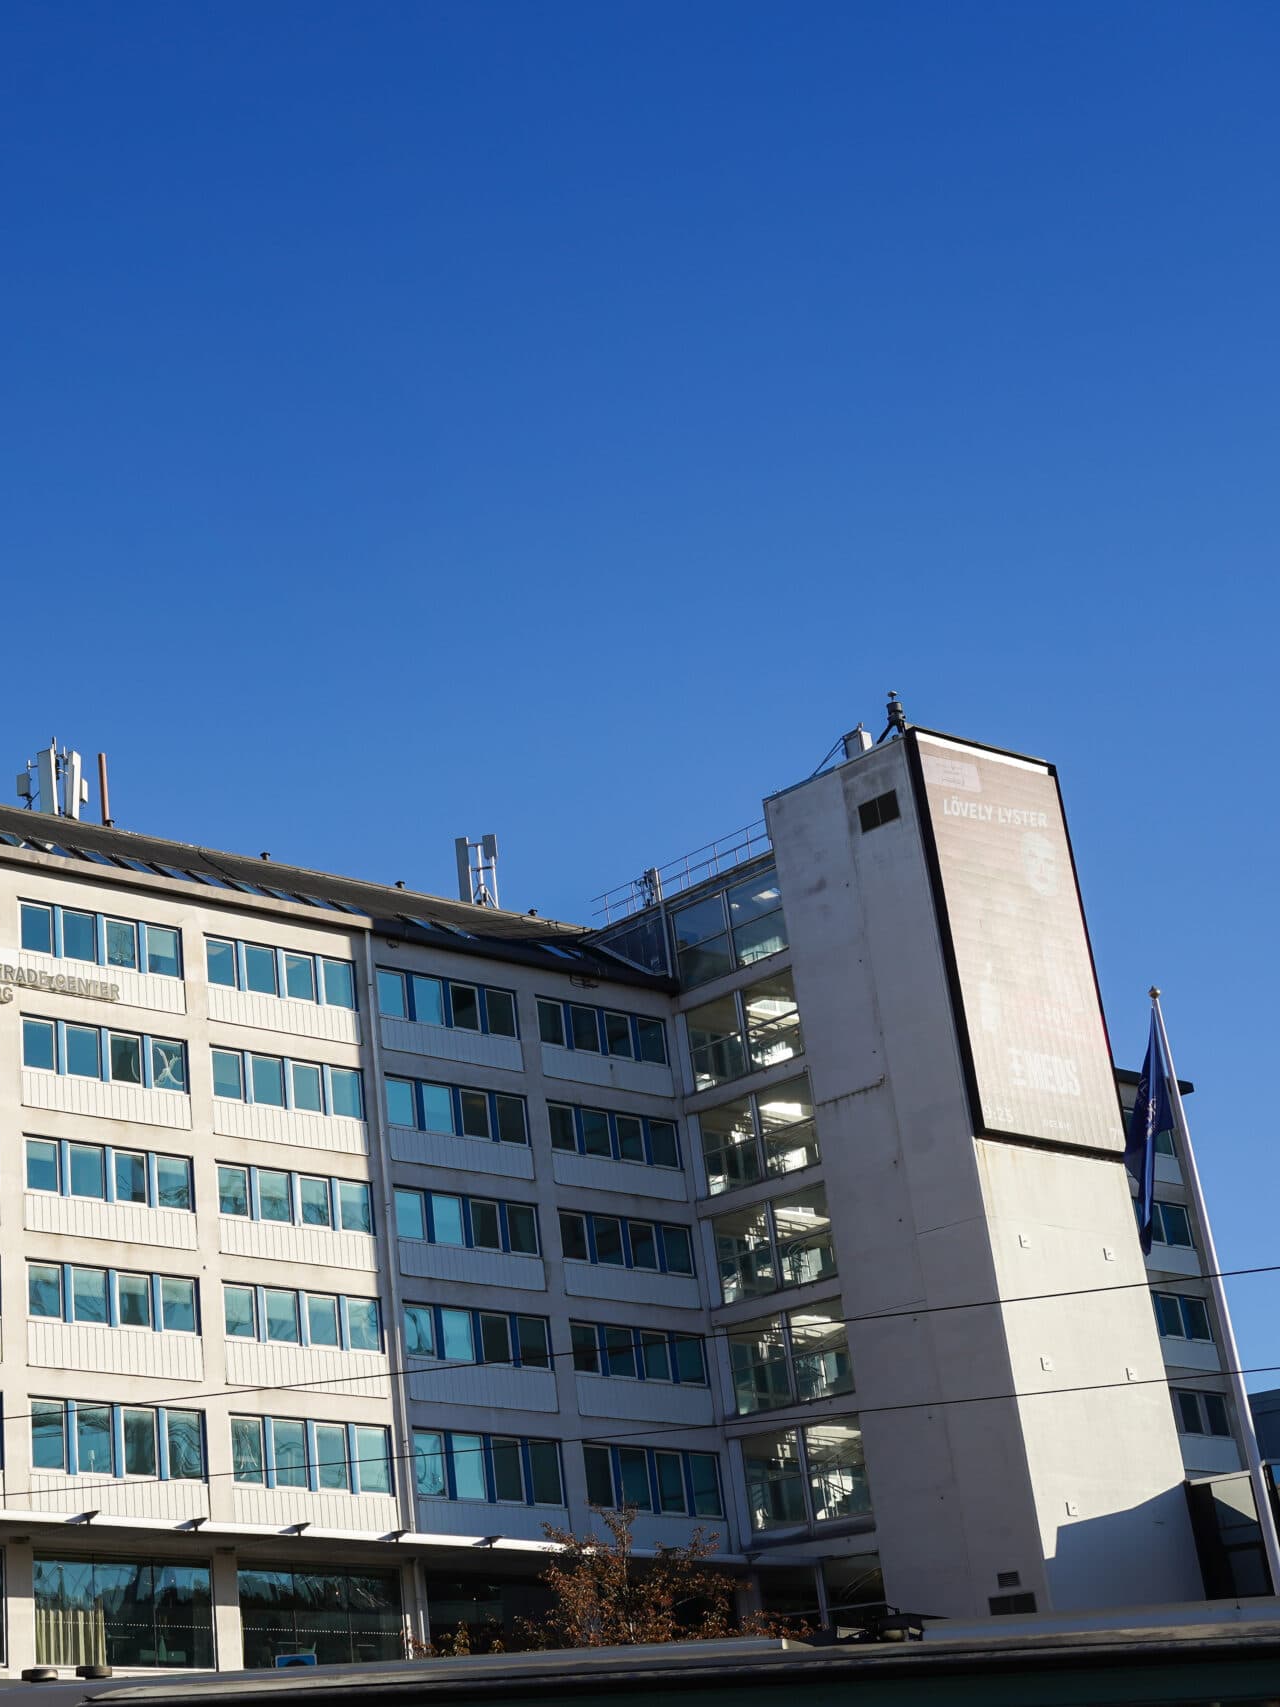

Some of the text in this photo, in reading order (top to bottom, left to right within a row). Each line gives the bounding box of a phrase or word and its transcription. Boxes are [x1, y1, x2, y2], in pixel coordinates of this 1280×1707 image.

[943, 795, 1048, 829] LÖVELY LYSTER
[55, 974, 120, 1000] CENTER
